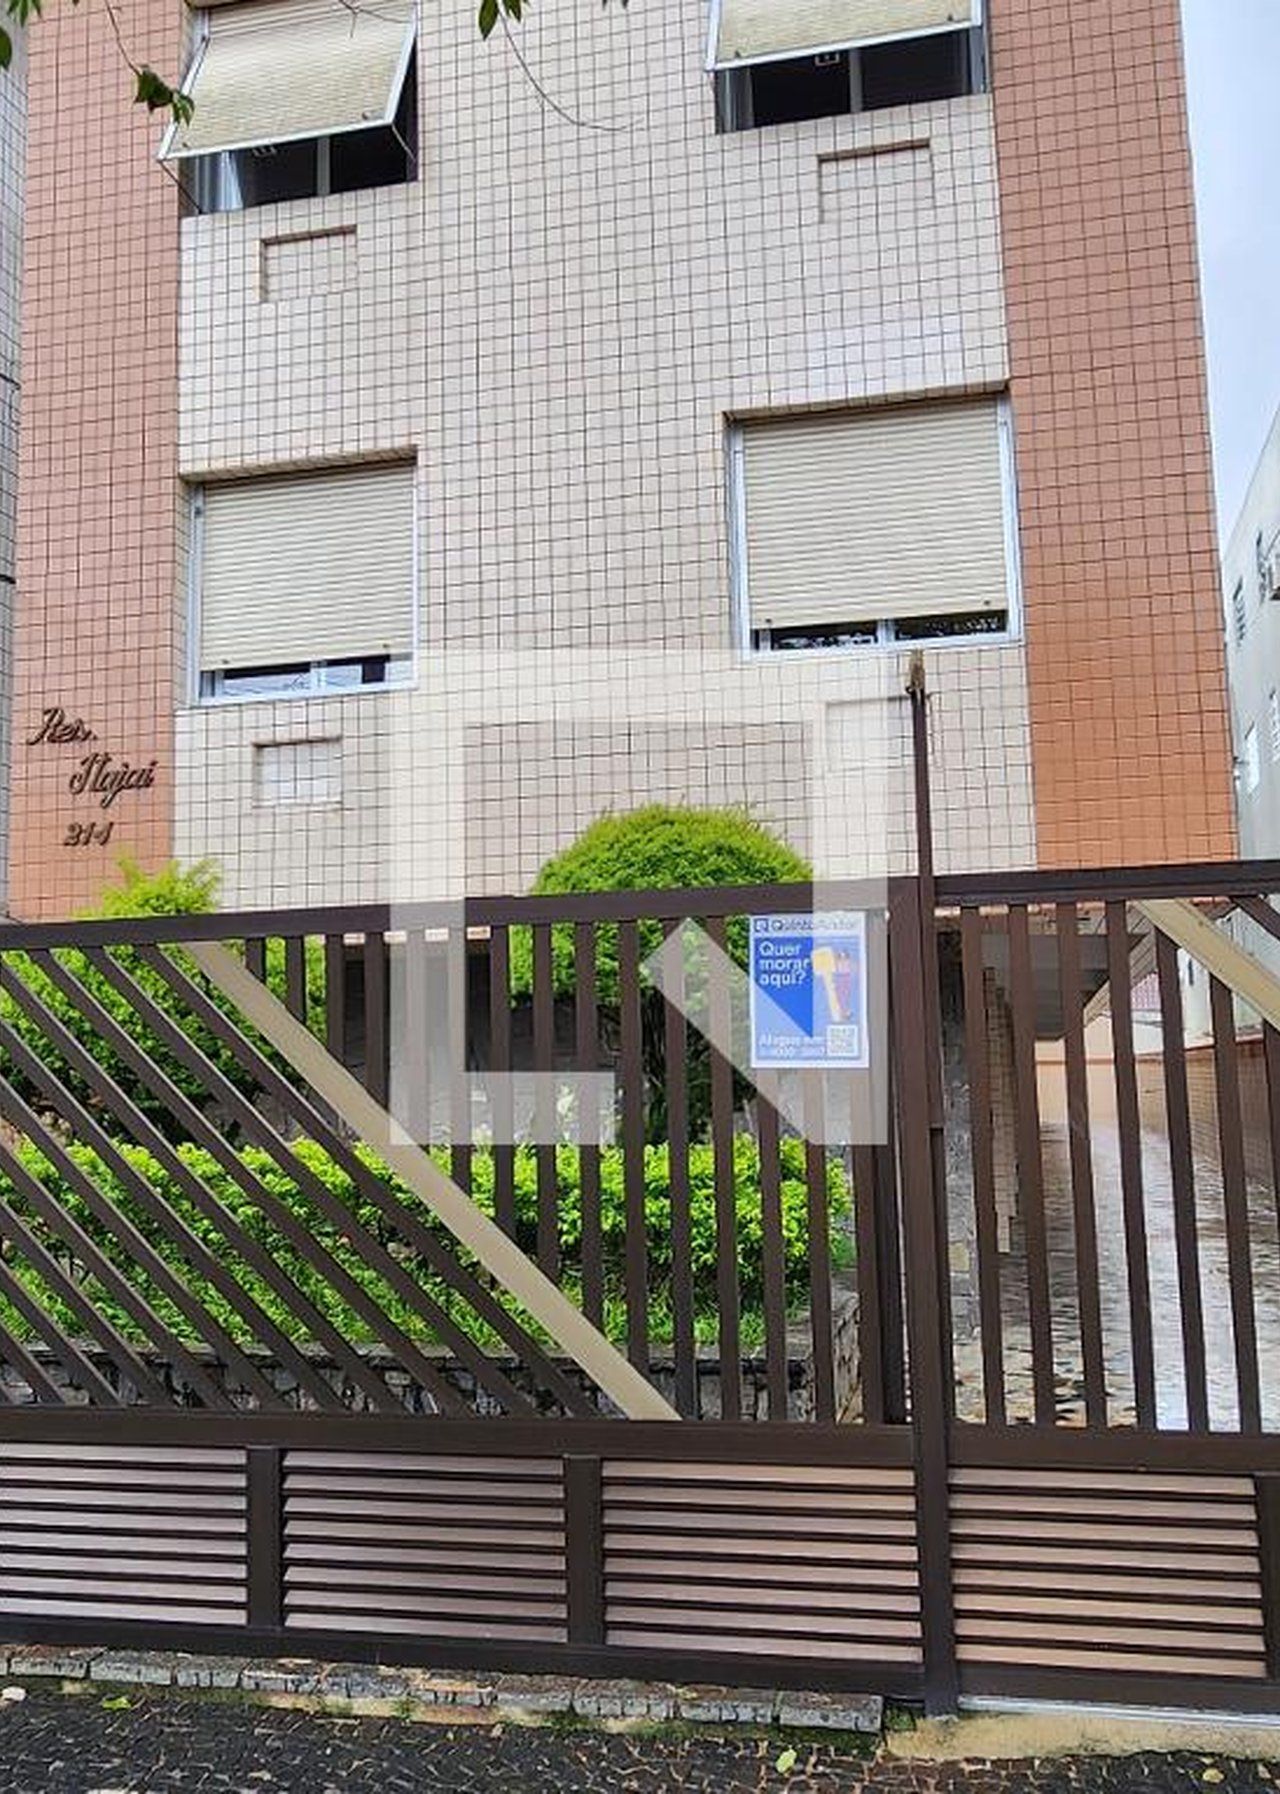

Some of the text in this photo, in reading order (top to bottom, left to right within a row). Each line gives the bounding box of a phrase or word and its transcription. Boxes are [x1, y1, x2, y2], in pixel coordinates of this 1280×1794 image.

[26, 707, 98, 745] Res.
[63, 822, 115, 846] 214
[759, 941, 800, 956] Quer
[759, 958, 810, 970] morar
[759, 971, 806, 987] aqui?
